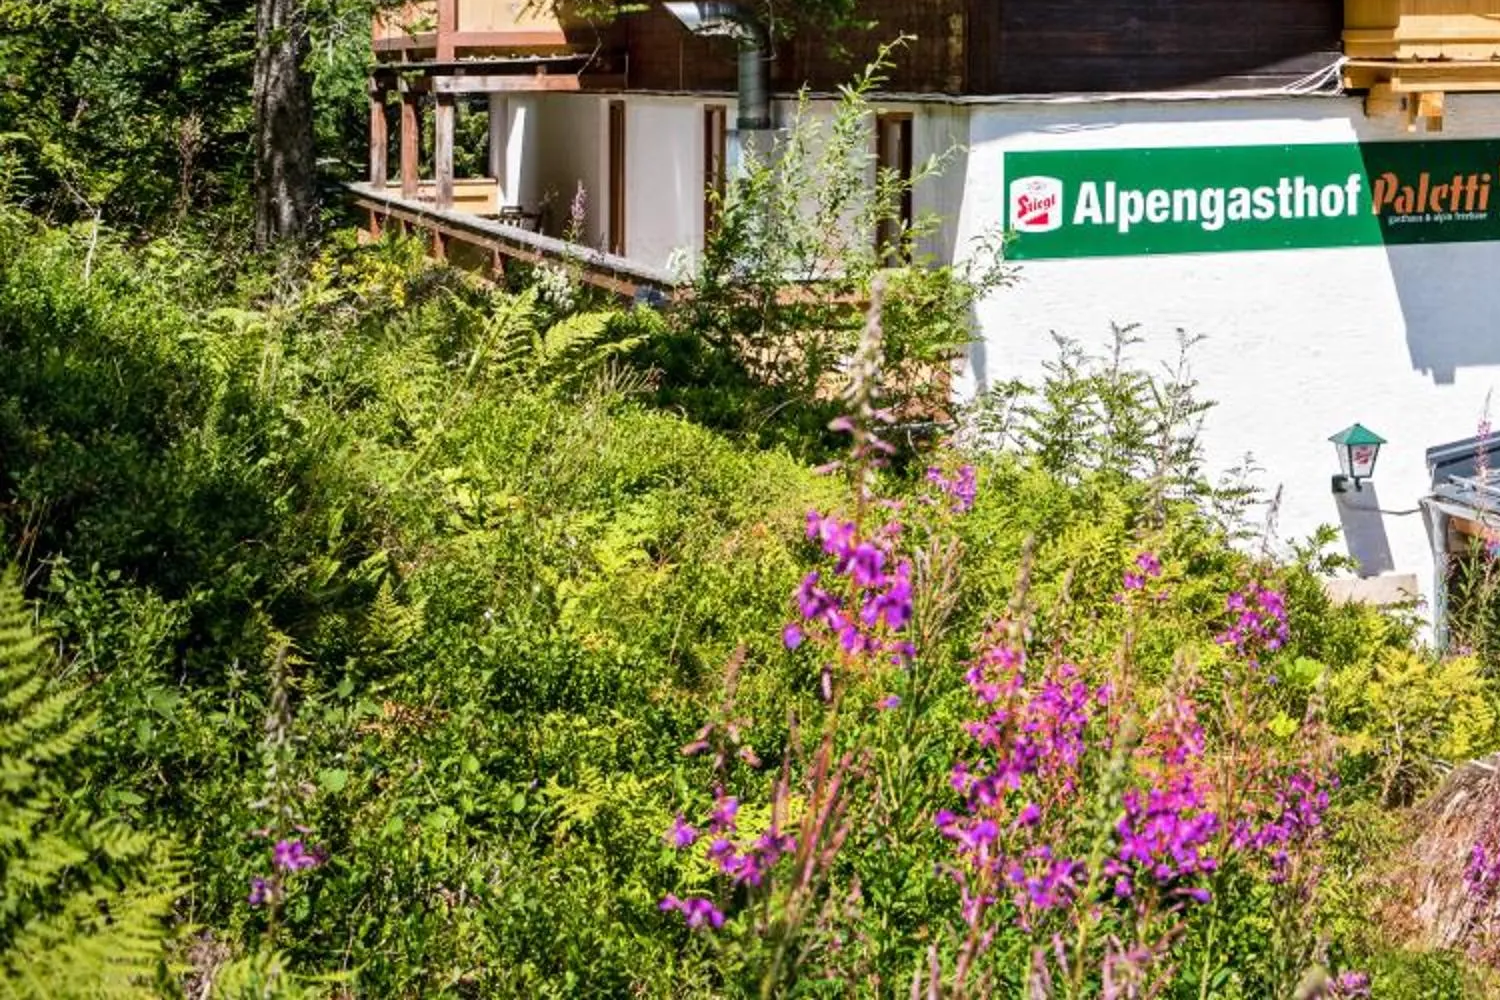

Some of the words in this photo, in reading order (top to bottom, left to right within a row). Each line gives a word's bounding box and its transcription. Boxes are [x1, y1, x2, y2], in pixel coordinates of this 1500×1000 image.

[1017, 193, 1056, 218] Stiegl
[1072, 174, 1362, 233] Alpengasthof
[1371, 171, 1492, 215] Paletti
